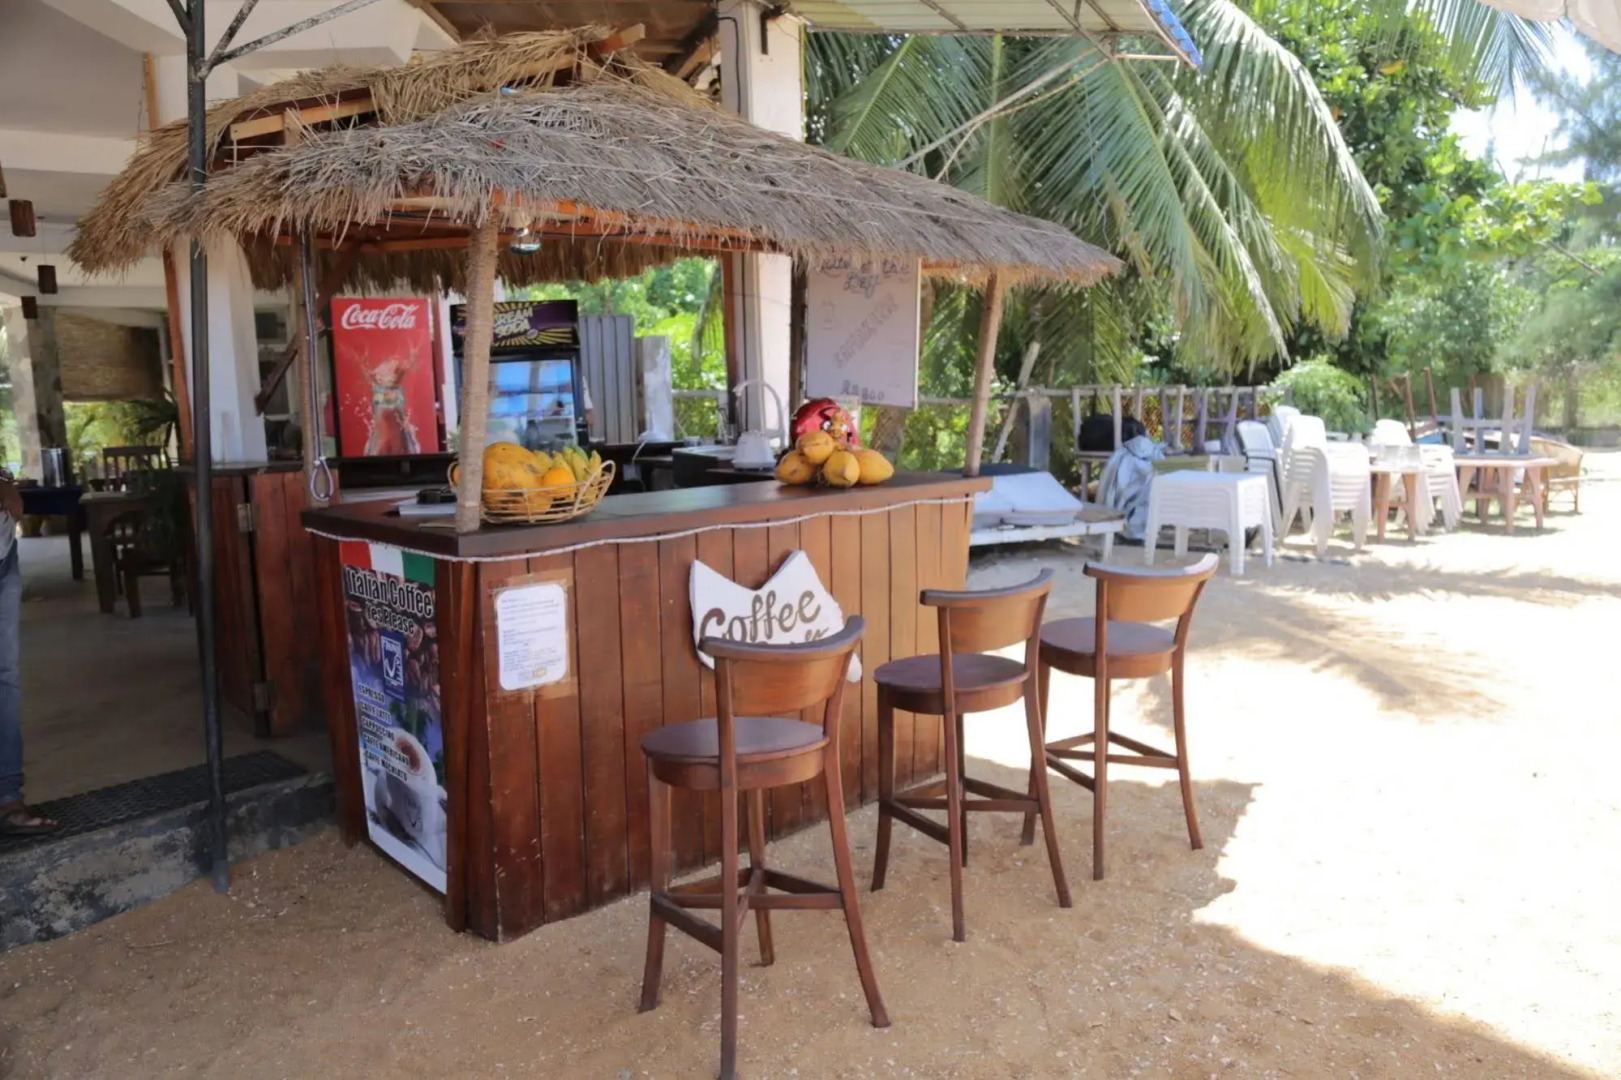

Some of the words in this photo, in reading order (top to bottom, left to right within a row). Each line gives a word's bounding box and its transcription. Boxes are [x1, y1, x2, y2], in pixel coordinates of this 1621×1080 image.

[341, 303, 419, 330] Coca-Cola
[494, 306, 533, 328] REAM
[495, 318, 531, 338] SODA
[346, 568, 388, 603] Italian
[389, 578, 433, 618] Coffee
[365, 601, 382, 623] Yes
[382, 605, 414, 636] Please
[701, 590, 821, 643] Coffee
[359, 683, 386, 705] ESPRESSO
